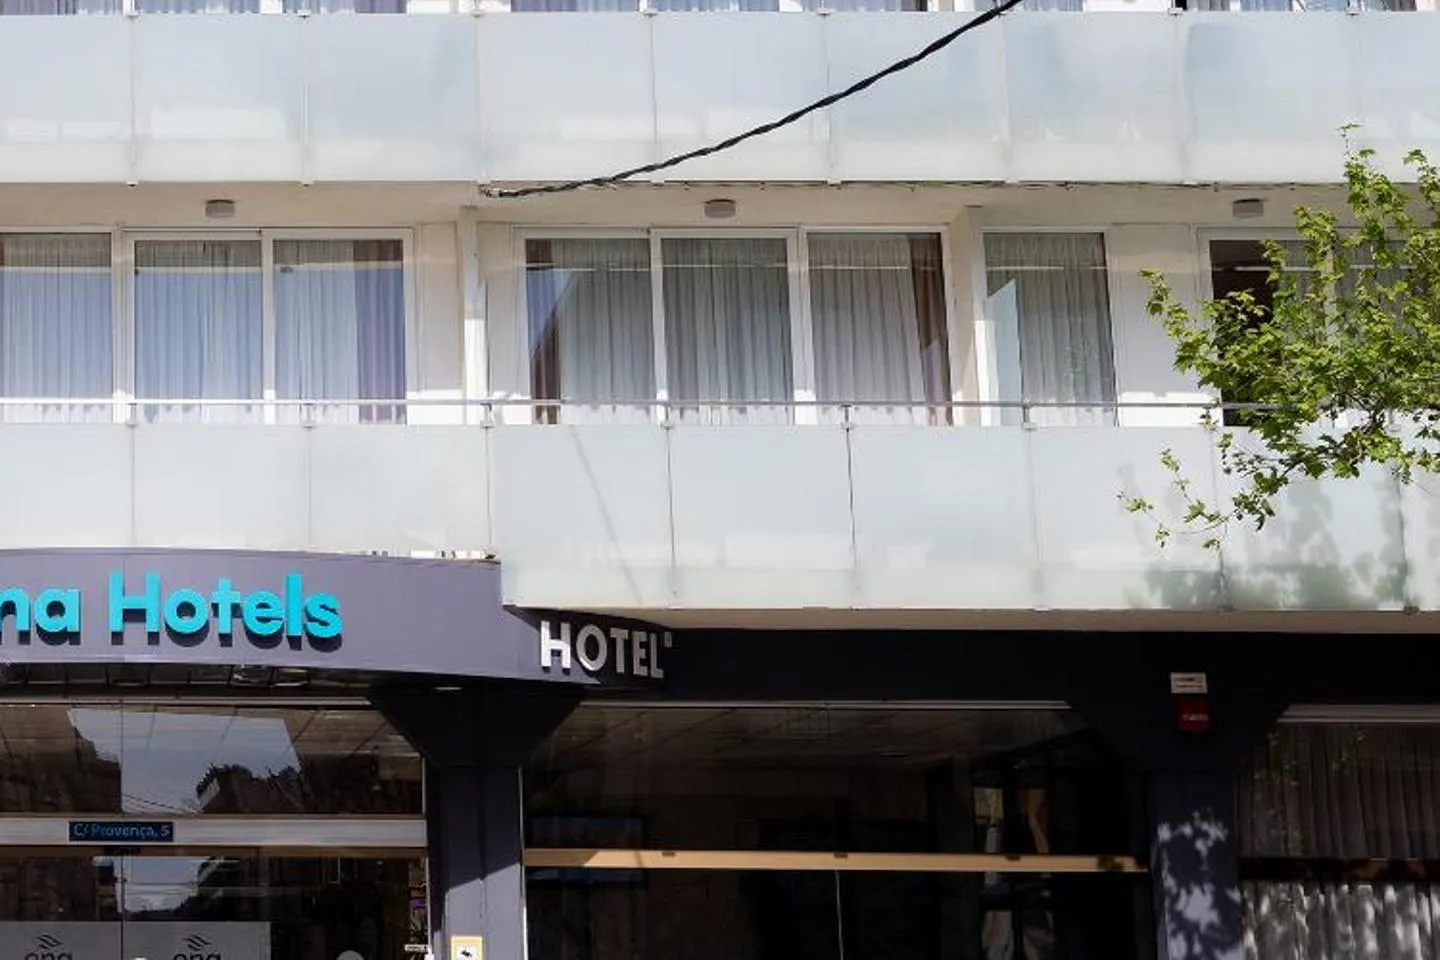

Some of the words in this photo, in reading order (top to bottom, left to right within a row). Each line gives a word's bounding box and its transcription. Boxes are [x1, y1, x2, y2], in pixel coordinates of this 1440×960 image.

[109, 572, 343, 641] Hotels
[541, 620, 664, 678] HOTEL
[160, 824, 171, 837] 5
